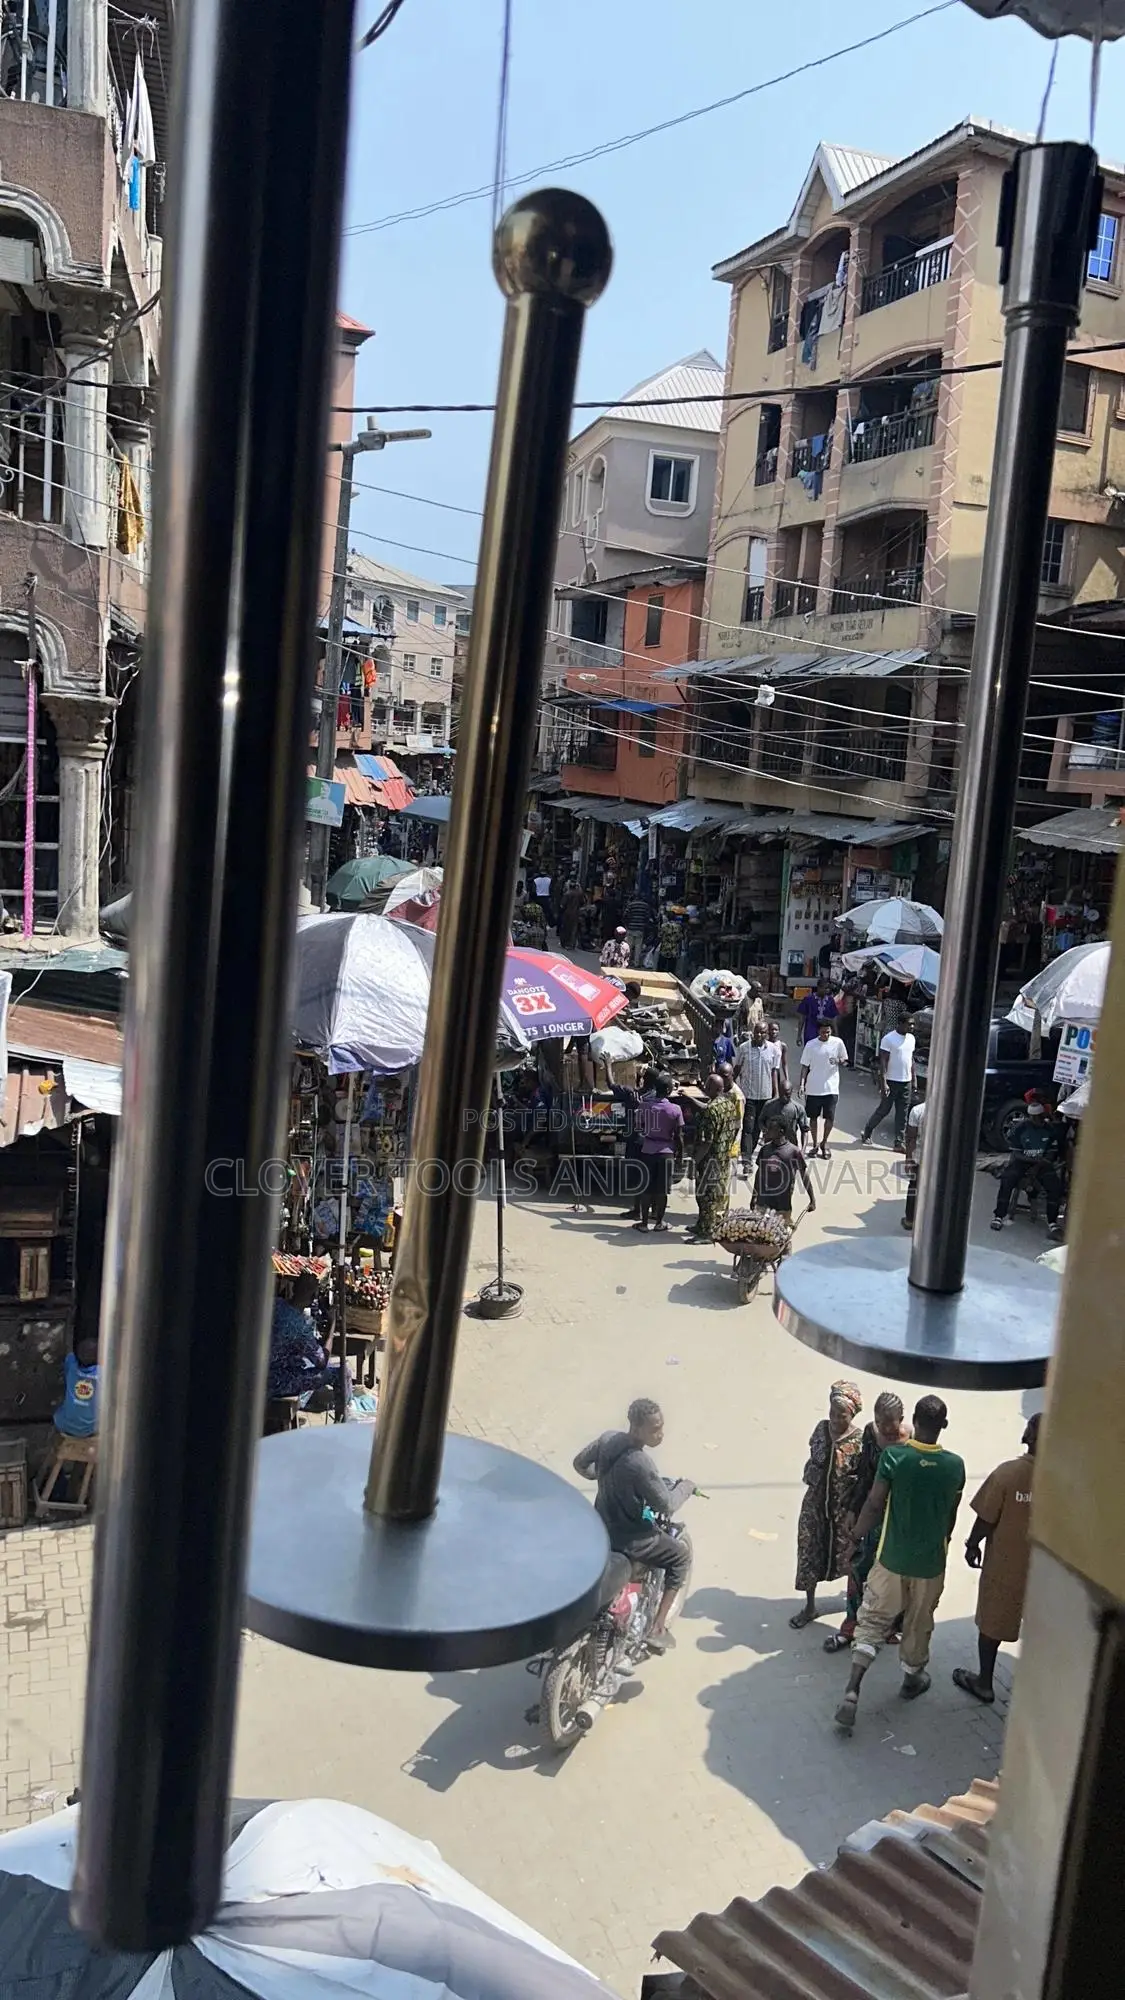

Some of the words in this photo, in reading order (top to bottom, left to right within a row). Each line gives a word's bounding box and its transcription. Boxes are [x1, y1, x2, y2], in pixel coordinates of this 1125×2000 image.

[506, 985, 546, 996] DANGOTE
[515, 994, 553, 1012] 3X
[542, 1022, 585, 1034] LONGER
